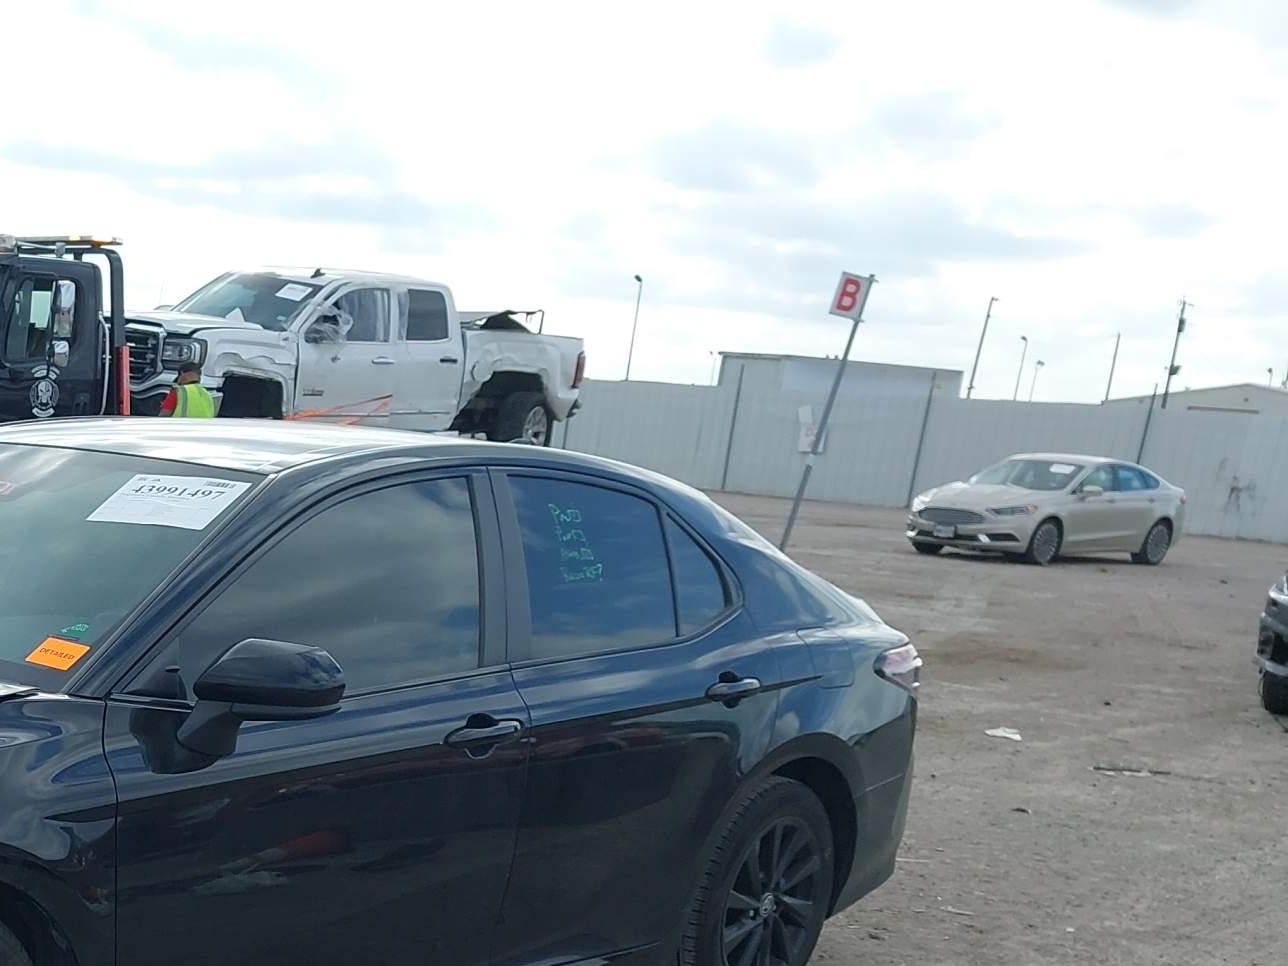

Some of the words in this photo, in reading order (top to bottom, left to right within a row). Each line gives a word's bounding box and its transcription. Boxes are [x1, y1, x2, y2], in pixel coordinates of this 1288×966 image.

[835, 278, 861, 312] B
[131, 484, 226, 500] 43991497
[39, 647, 76, 660] DETAILED
